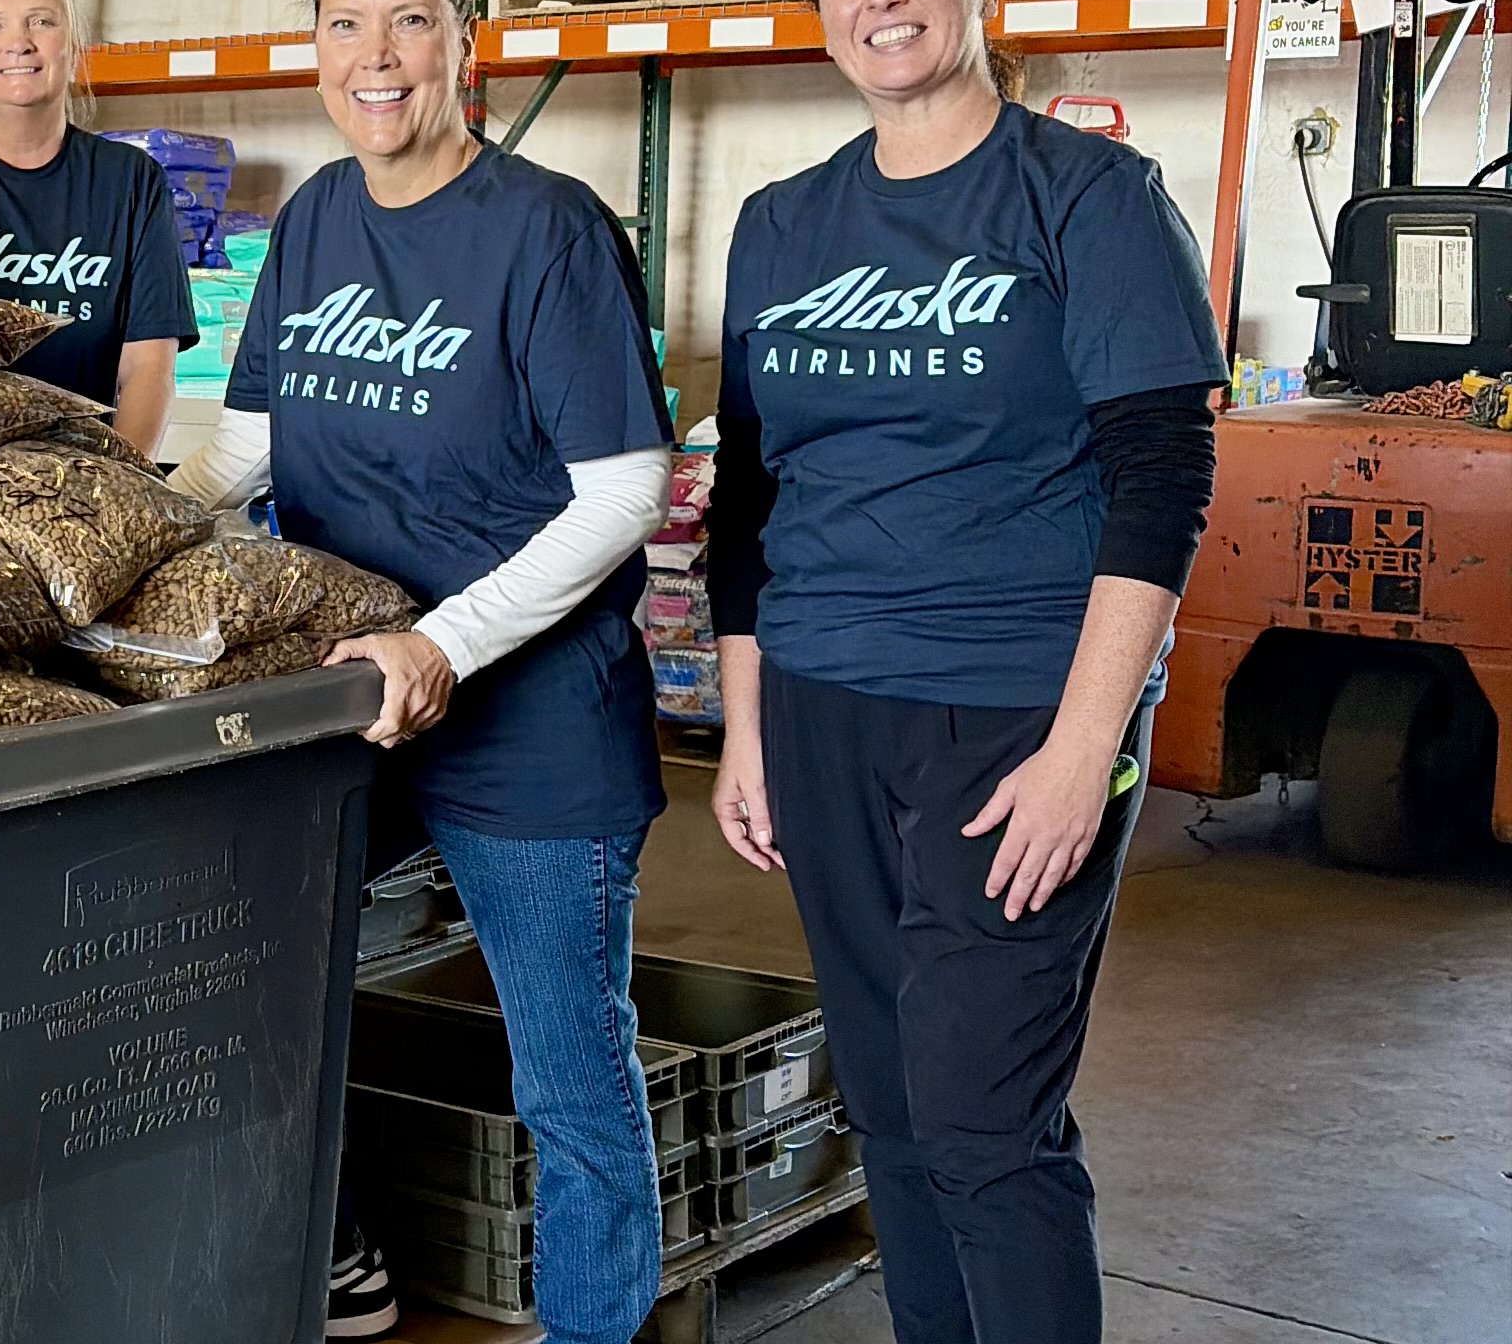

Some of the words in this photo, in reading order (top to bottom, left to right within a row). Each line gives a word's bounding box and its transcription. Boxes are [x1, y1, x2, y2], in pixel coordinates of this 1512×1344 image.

[1272, 37, 1287, 48] ON
[1291, 35, 1335, 48] CAMERA
[1285, 19, 1324, 32] YOU'RE
[755, 255, 1013, 336] Alaska
[278, 283, 473, 377] Alaska
[762, 346, 985, 377] AIRLINES
[279, 371, 431, 416] AIRLINES
[1307, 545, 1422, 576] HYSTER
[42, 939, 98, 976] 4619
[104, 919, 174, 961] CUBE
[177, 898, 254, 943] TRUCK
[100, 963, 192, 1003] Commercial
[144, 985, 202, 1014] Virginia
[109, 1026, 187, 1066] VOLUME
[71, 1086, 159, 1132] MAXIMUM
[165, 1071, 217, 1102] LOAD
